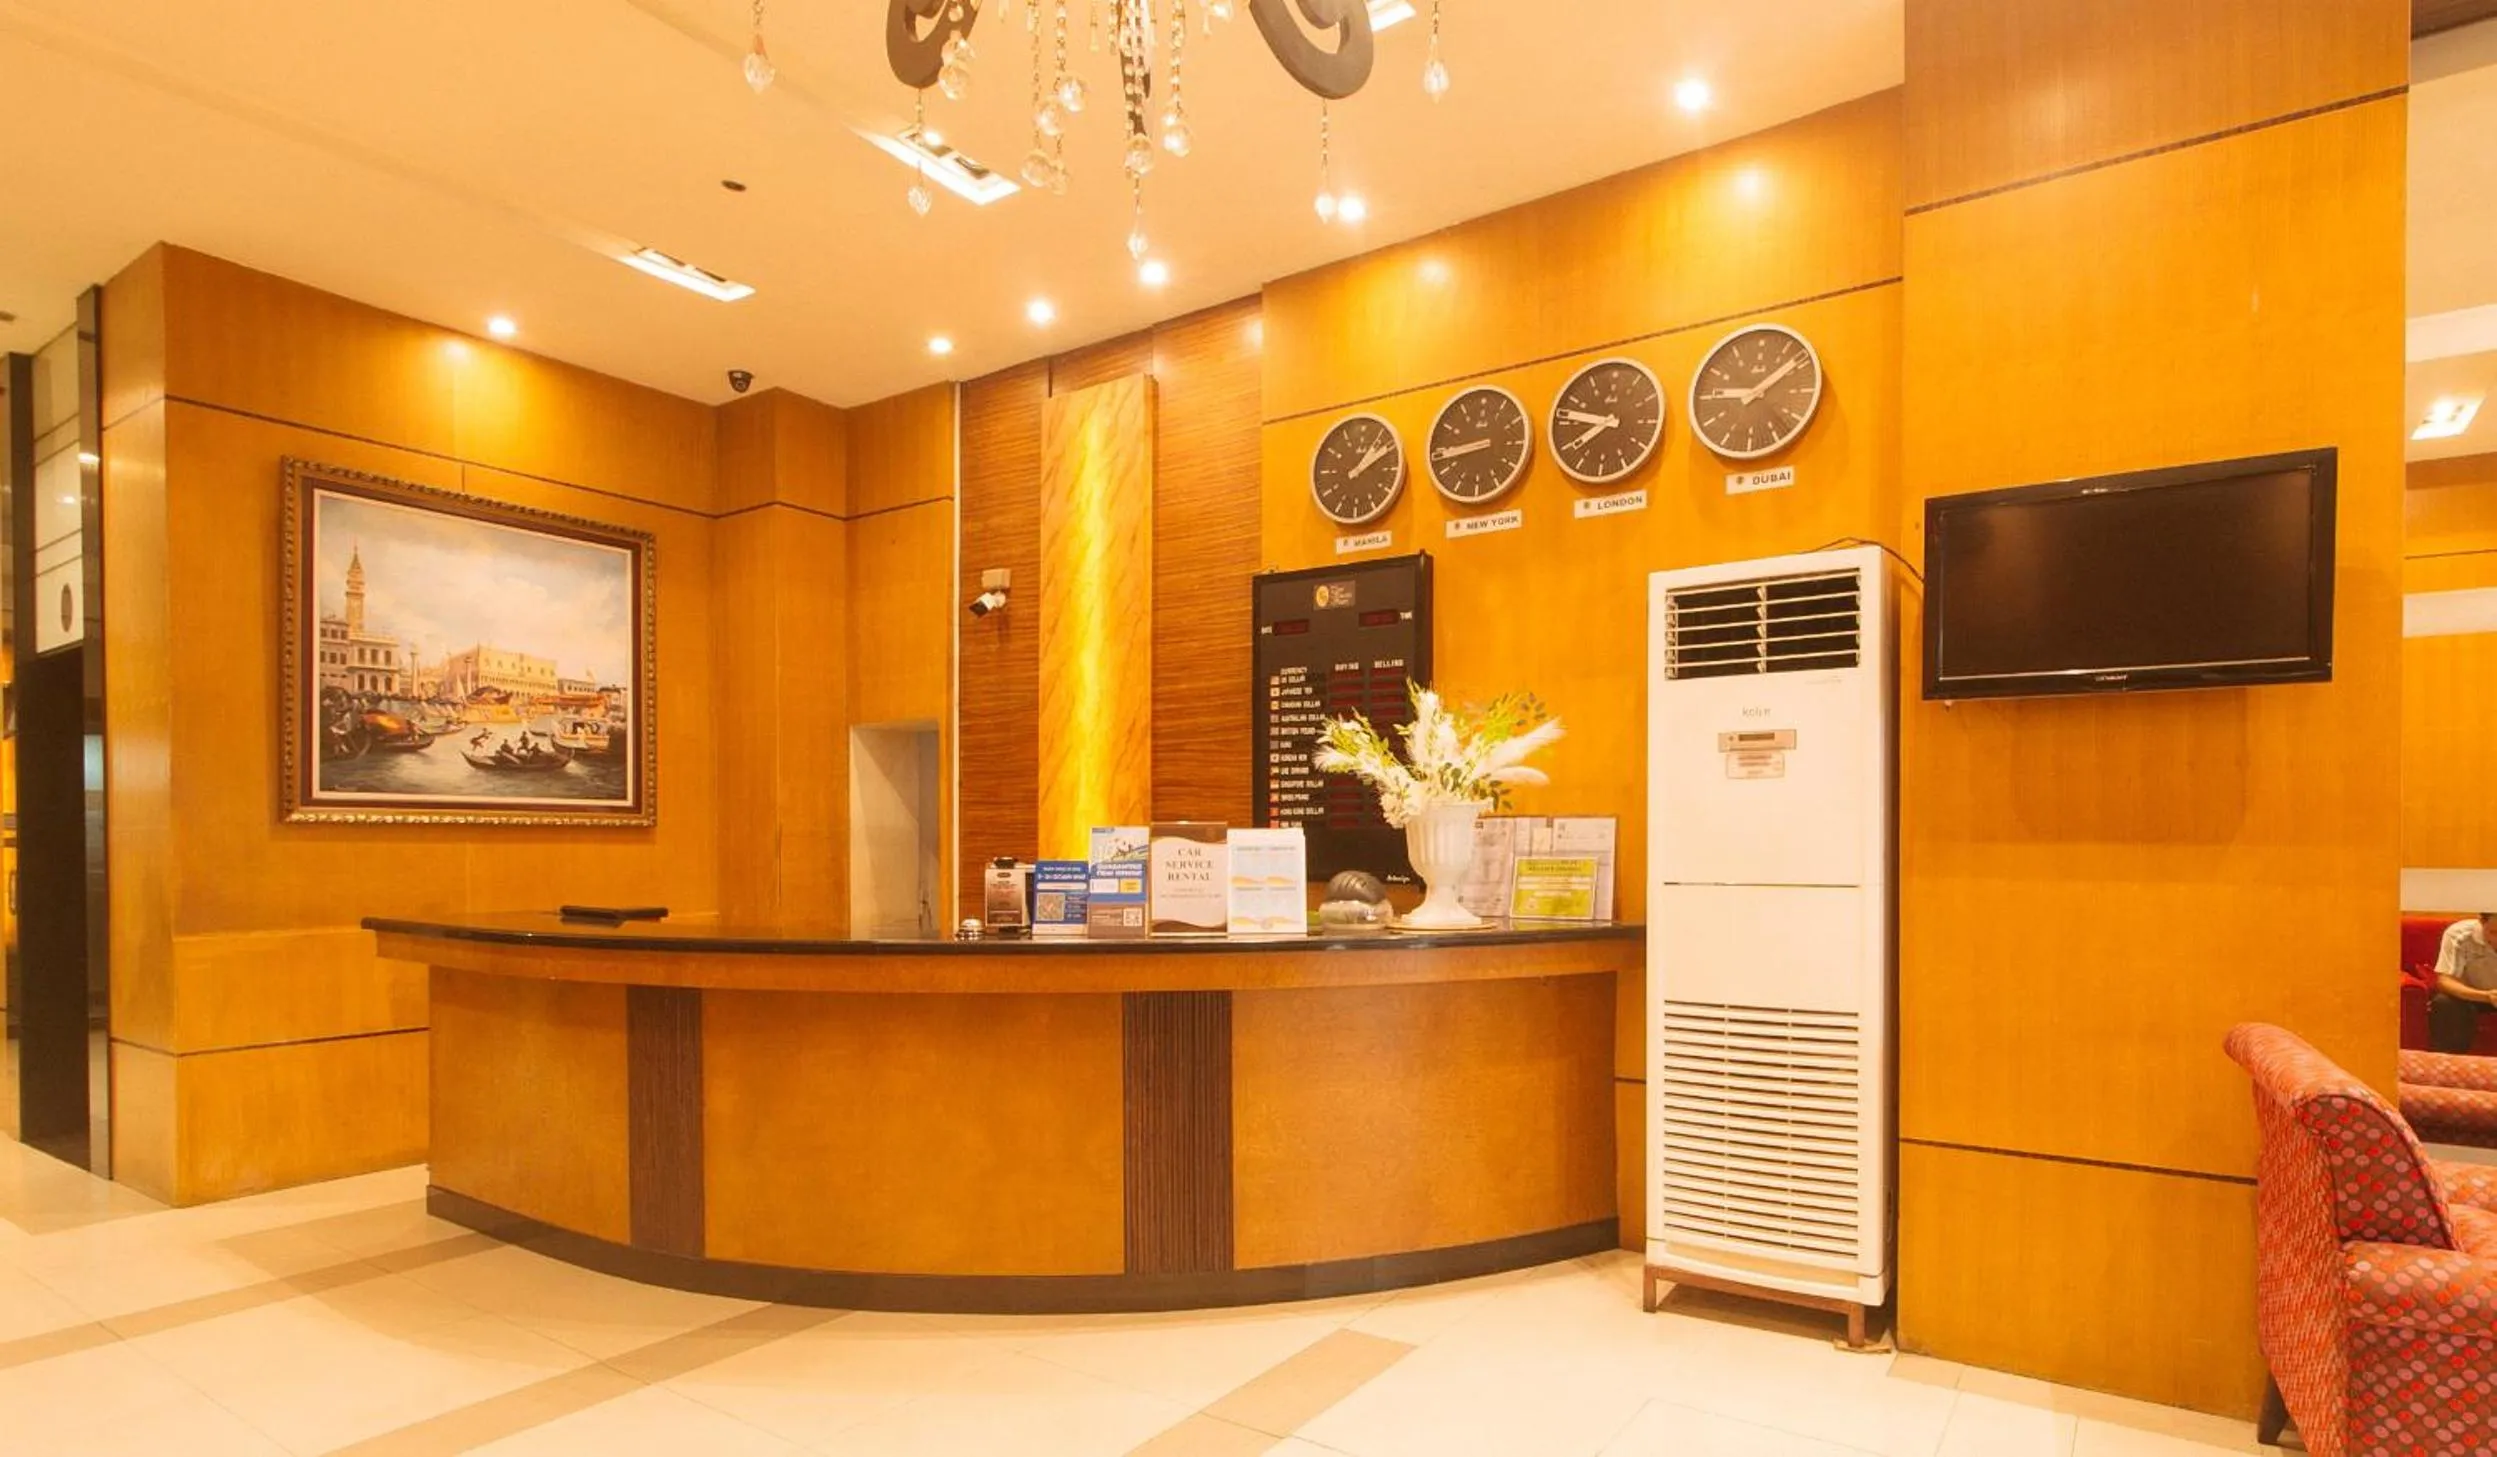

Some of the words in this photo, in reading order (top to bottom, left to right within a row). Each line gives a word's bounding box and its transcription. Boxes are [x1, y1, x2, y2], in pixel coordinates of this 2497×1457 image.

[1752, 470, 1790, 485] DUBAI
[1597, 496, 1642, 510] LONDON
[1466, 520, 1489, 529] NEW
[1491, 515, 1518, 526] YORK
[1353, 534, 1388, 547] MANILA
[1335, 662, 1359, 671] BUYING
[1374, 659, 1403, 668] SELLING
[1177, 848, 1201, 857] CAR
[1165, 860, 1213, 870] SERVICE
[1167, 872, 1211, 881] RENTAL
